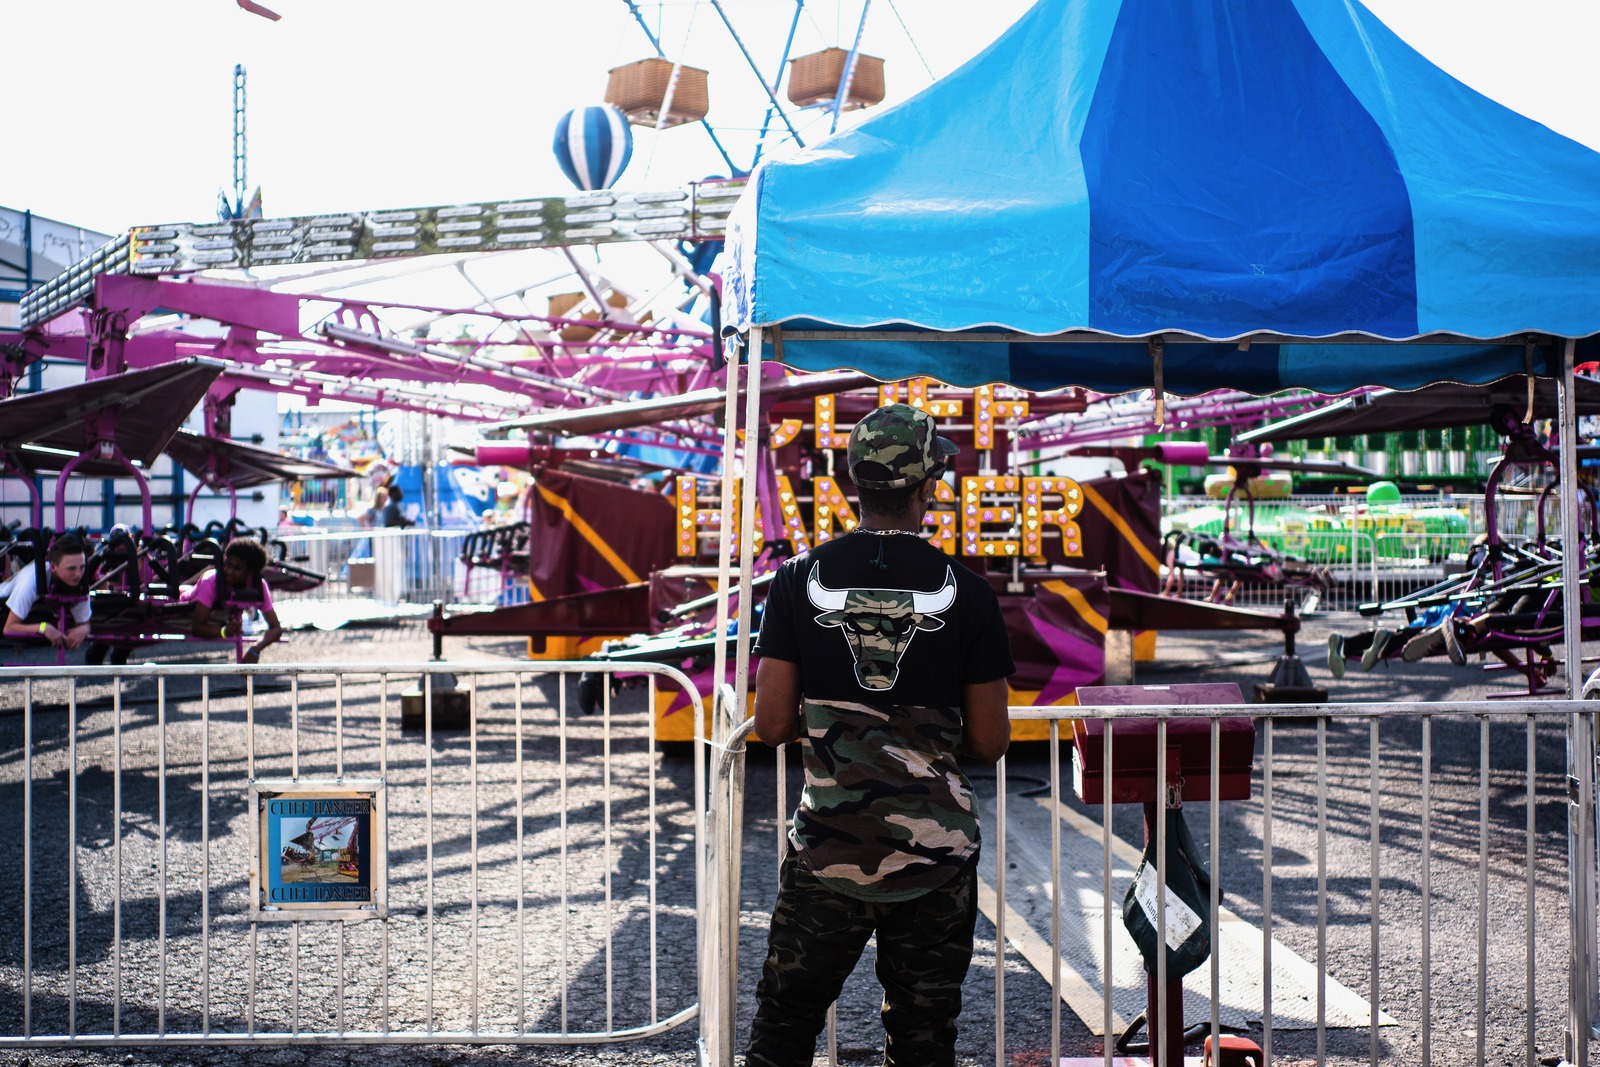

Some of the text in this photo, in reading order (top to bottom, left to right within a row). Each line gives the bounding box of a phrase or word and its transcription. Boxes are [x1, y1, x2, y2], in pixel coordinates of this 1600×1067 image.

[270, 801, 370, 815] CLIFF HANGER
[272, 887, 370, 900] CLIFF HANGER
